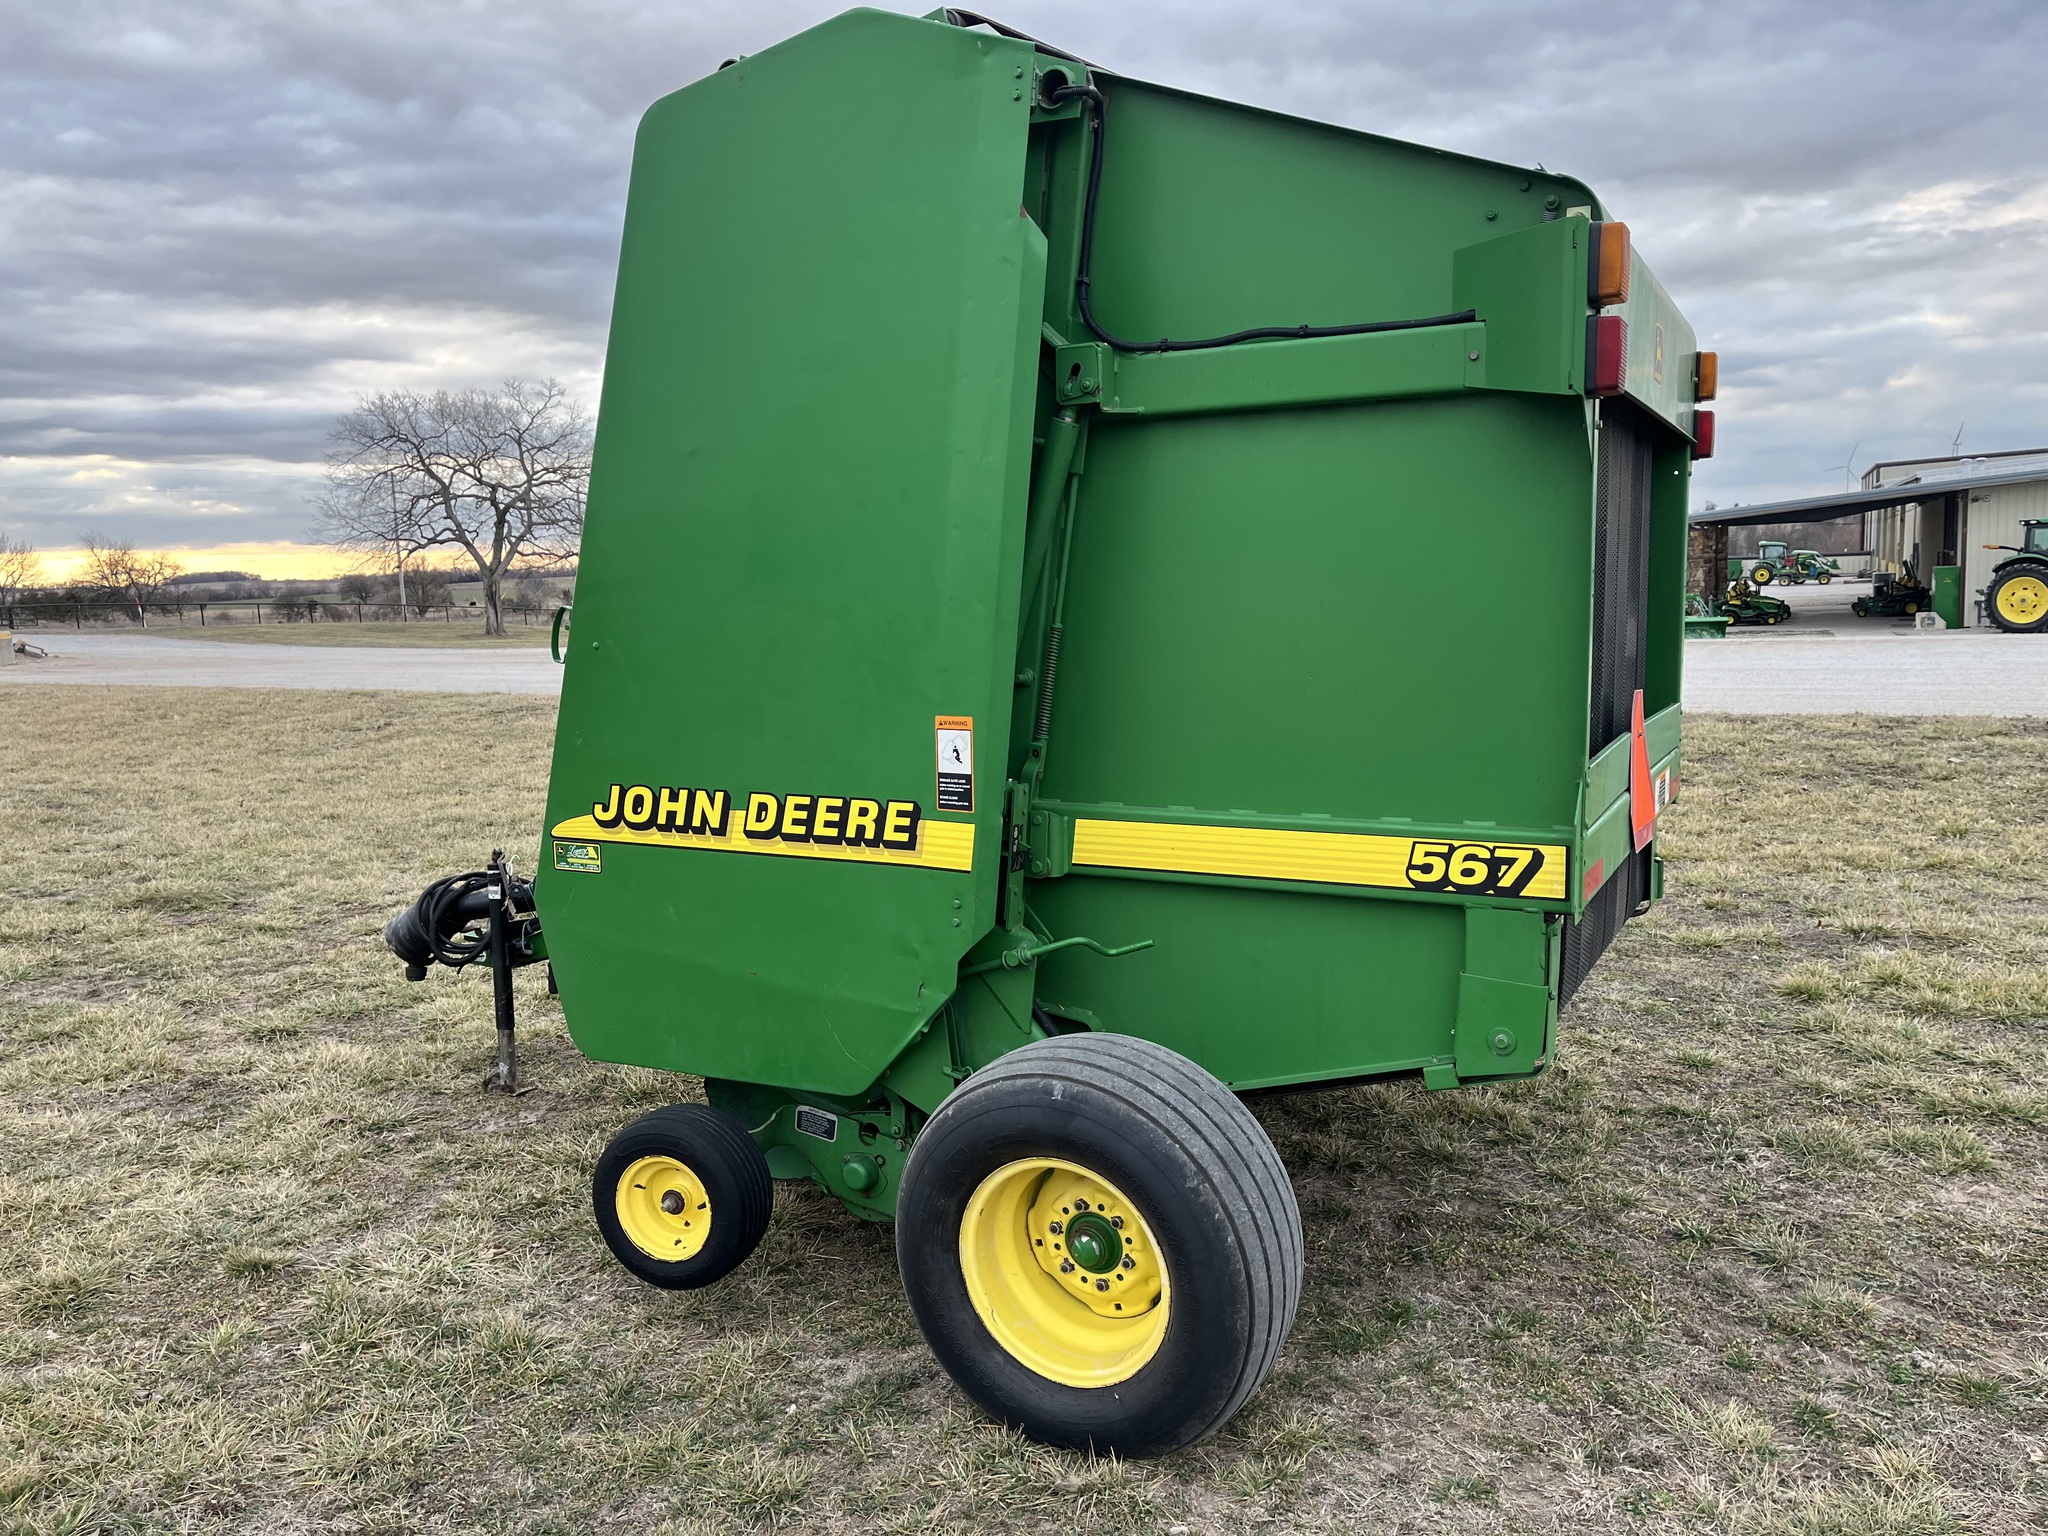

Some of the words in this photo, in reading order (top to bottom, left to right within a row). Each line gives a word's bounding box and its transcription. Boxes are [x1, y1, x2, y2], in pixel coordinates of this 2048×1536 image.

[593, 783, 731, 837] JOHN
[744, 791, 921, 851] DEERE
[1405, 841, 1545, 897] 567
[923, 1284, 956, 1335] MAX
[952, 1339, 995, 1388] CROP
